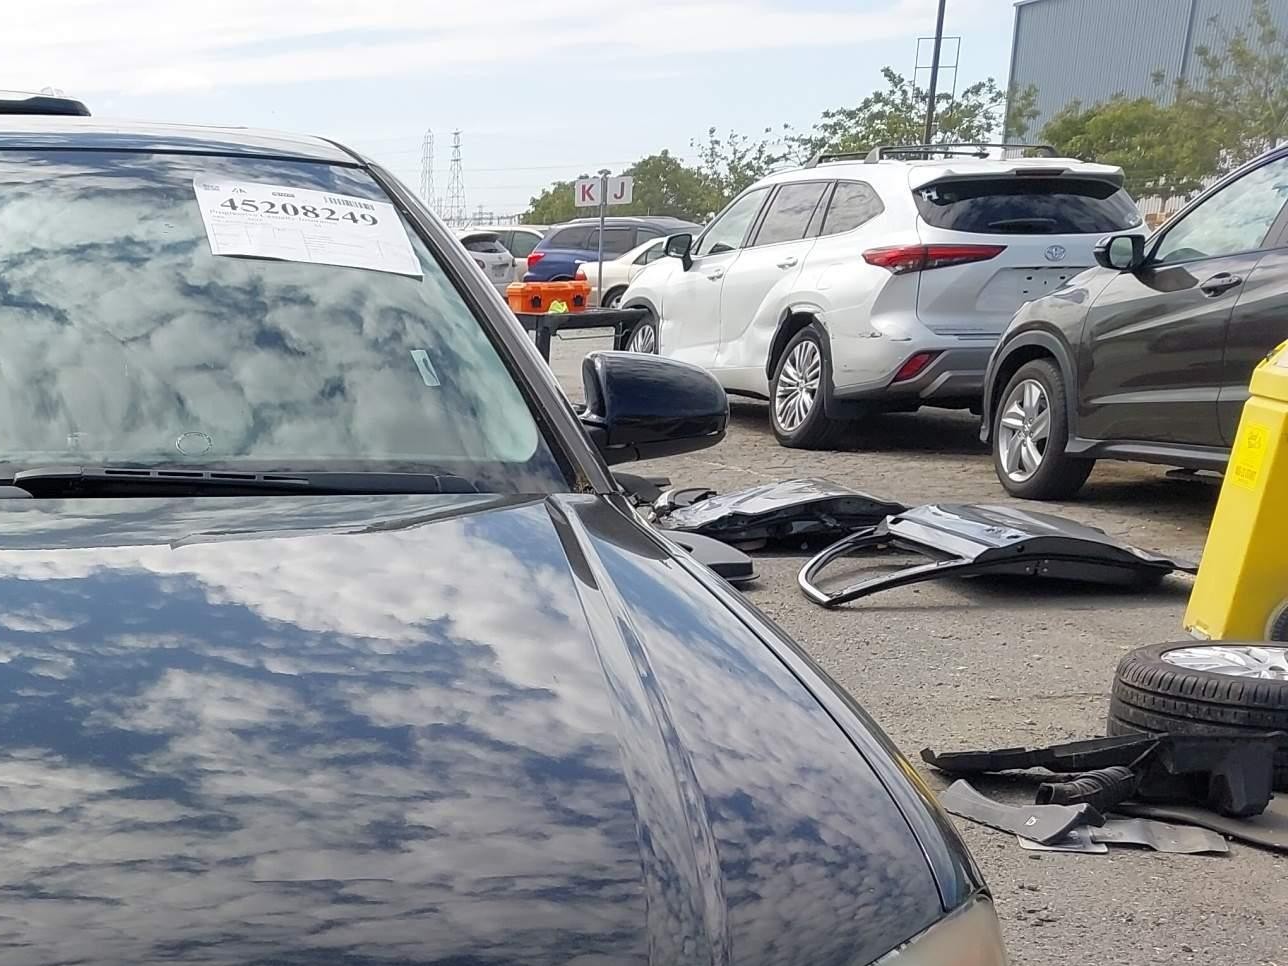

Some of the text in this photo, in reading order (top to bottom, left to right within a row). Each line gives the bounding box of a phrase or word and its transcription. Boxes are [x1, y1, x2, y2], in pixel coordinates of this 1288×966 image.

[581, 183, 595, 202] K
[613, 181, 625, 200] J
[220, 197, 378, 226] 45208249
